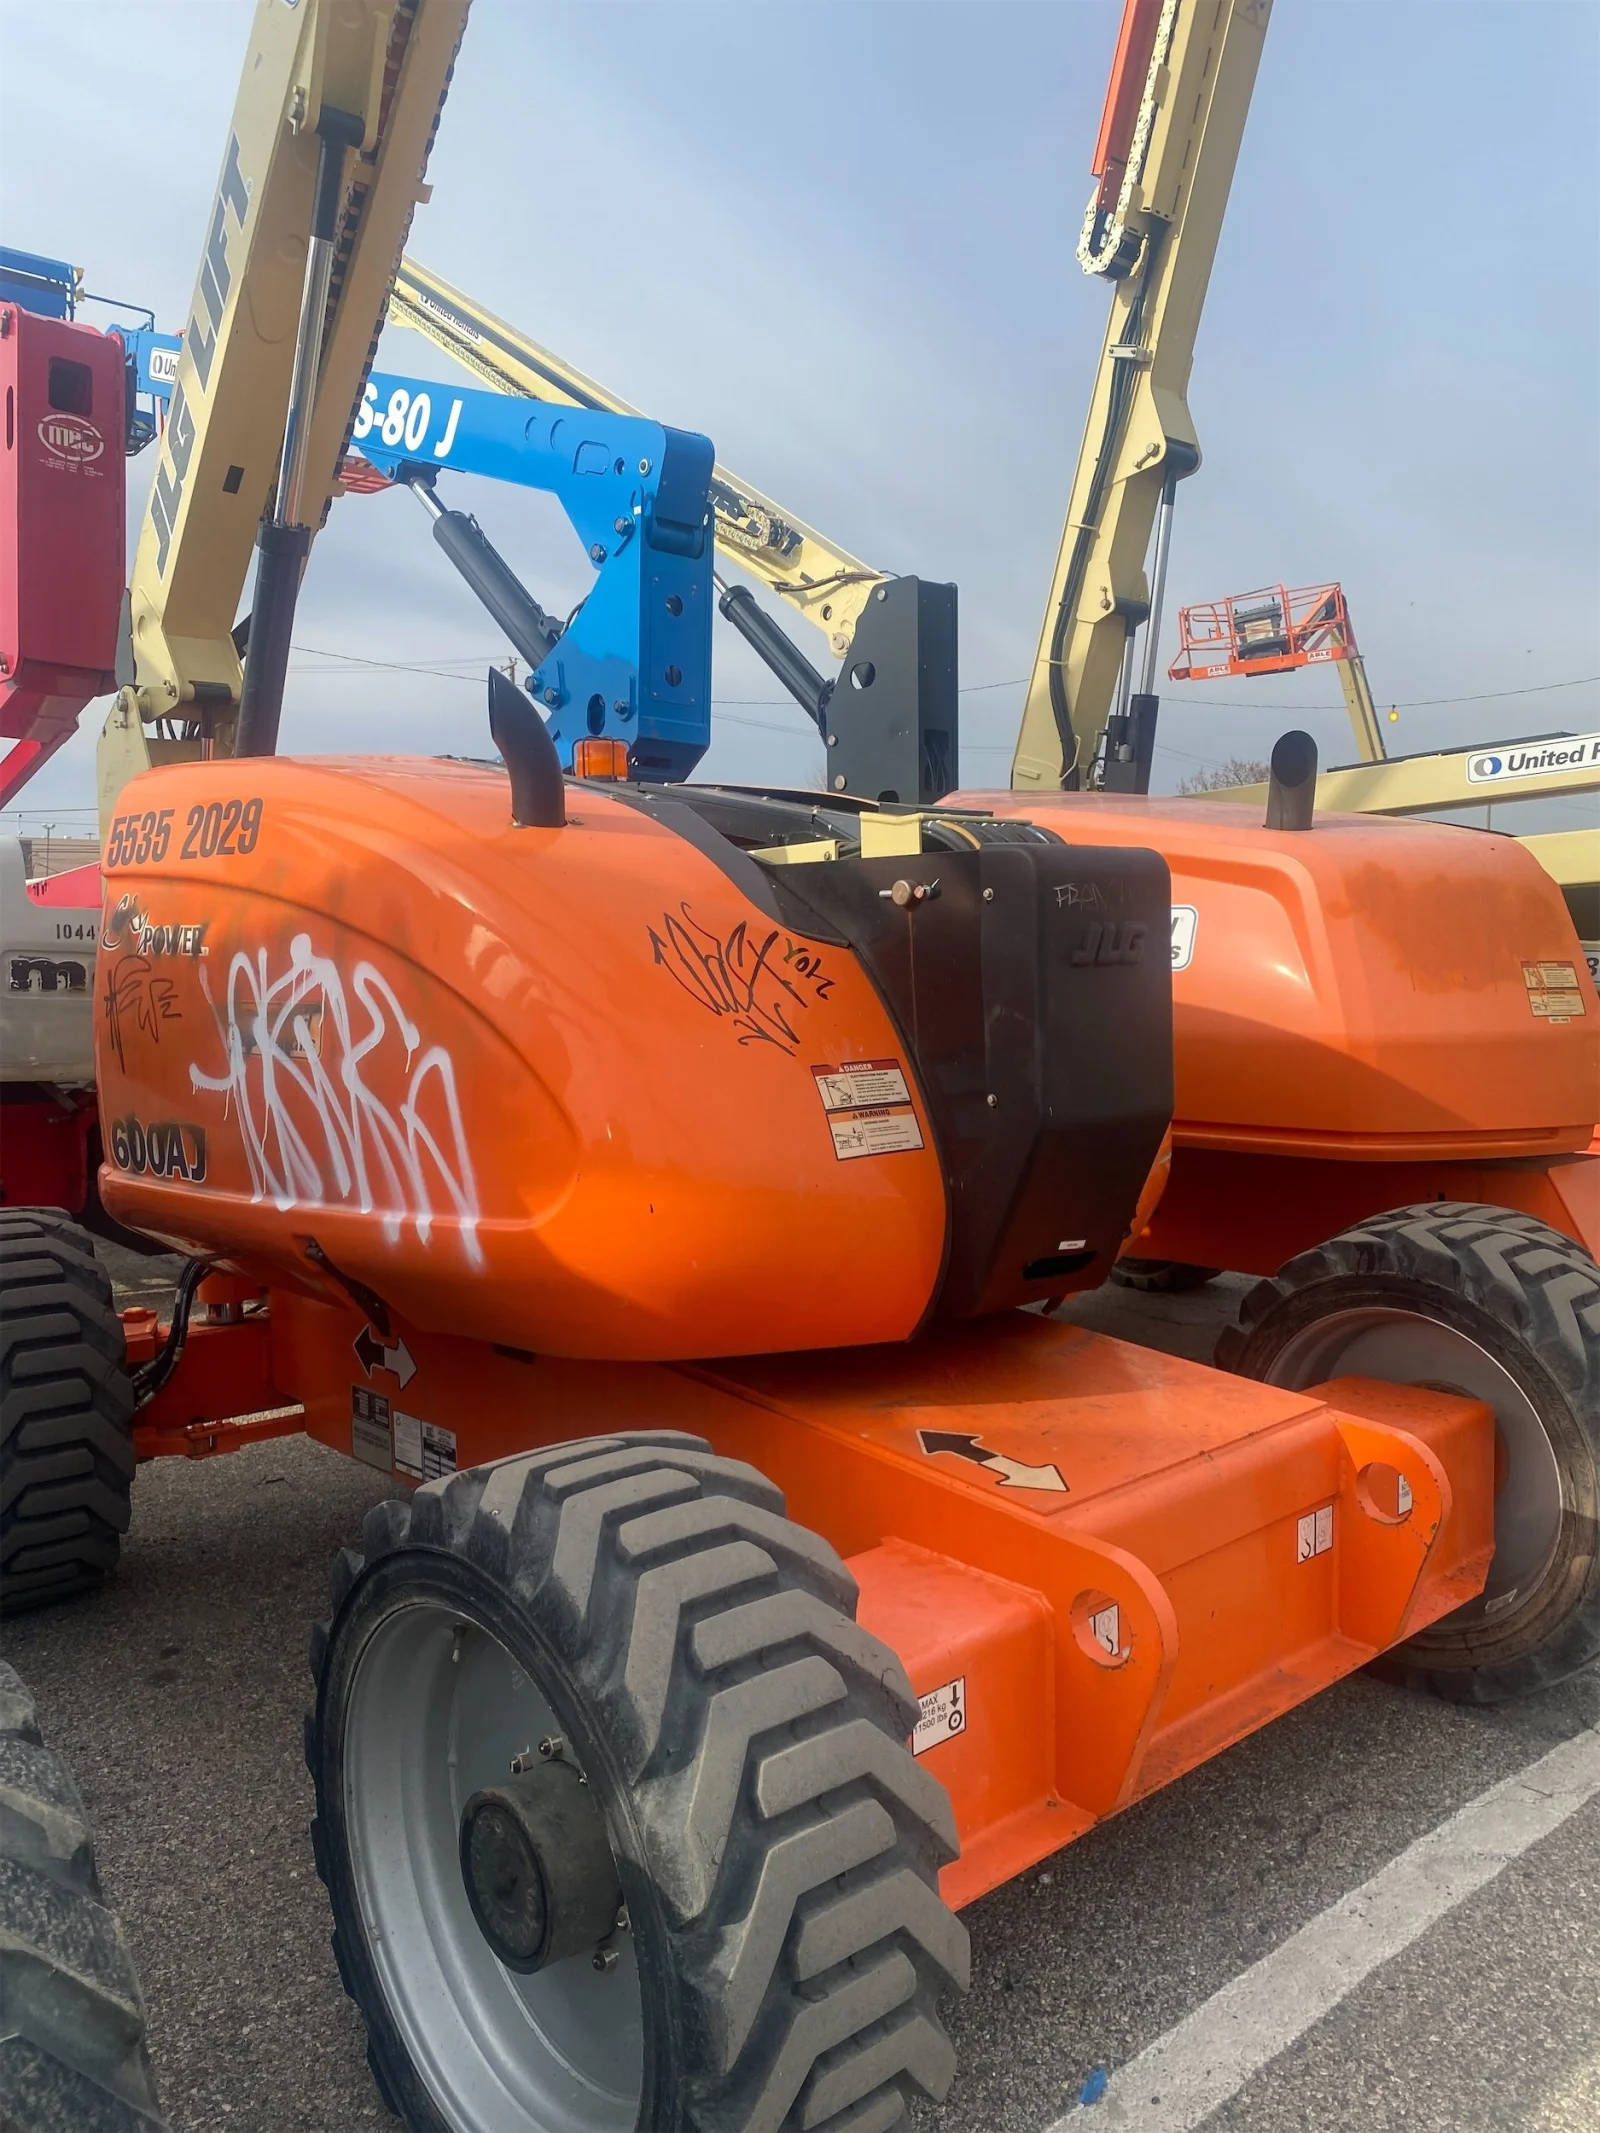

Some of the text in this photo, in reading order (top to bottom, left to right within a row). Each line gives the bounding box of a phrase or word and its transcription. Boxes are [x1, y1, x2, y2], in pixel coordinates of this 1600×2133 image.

[150, 130, 249, 584] JLG LIFT
[164, 357, 179, 377] Un
[353, 382, 464, 458] S-80 J
[1507, 744, 1586, 772] United
[107, 798, 263, 868] 5535 2029
[56, 923, 101, 940] 1044
[1071, 921, 1148, 966] JLG
[844, 1063, 873, 1073] DANGER
[858, 1108, 891, 1119] WARNING
[112, 1116, 207, 1183] 600AJ
[921, 1694, 938, 1711] MAX
[922, 1702, 947, 1720] 216 kg
[914, 1712, 948, 1734] 11500 lbs
